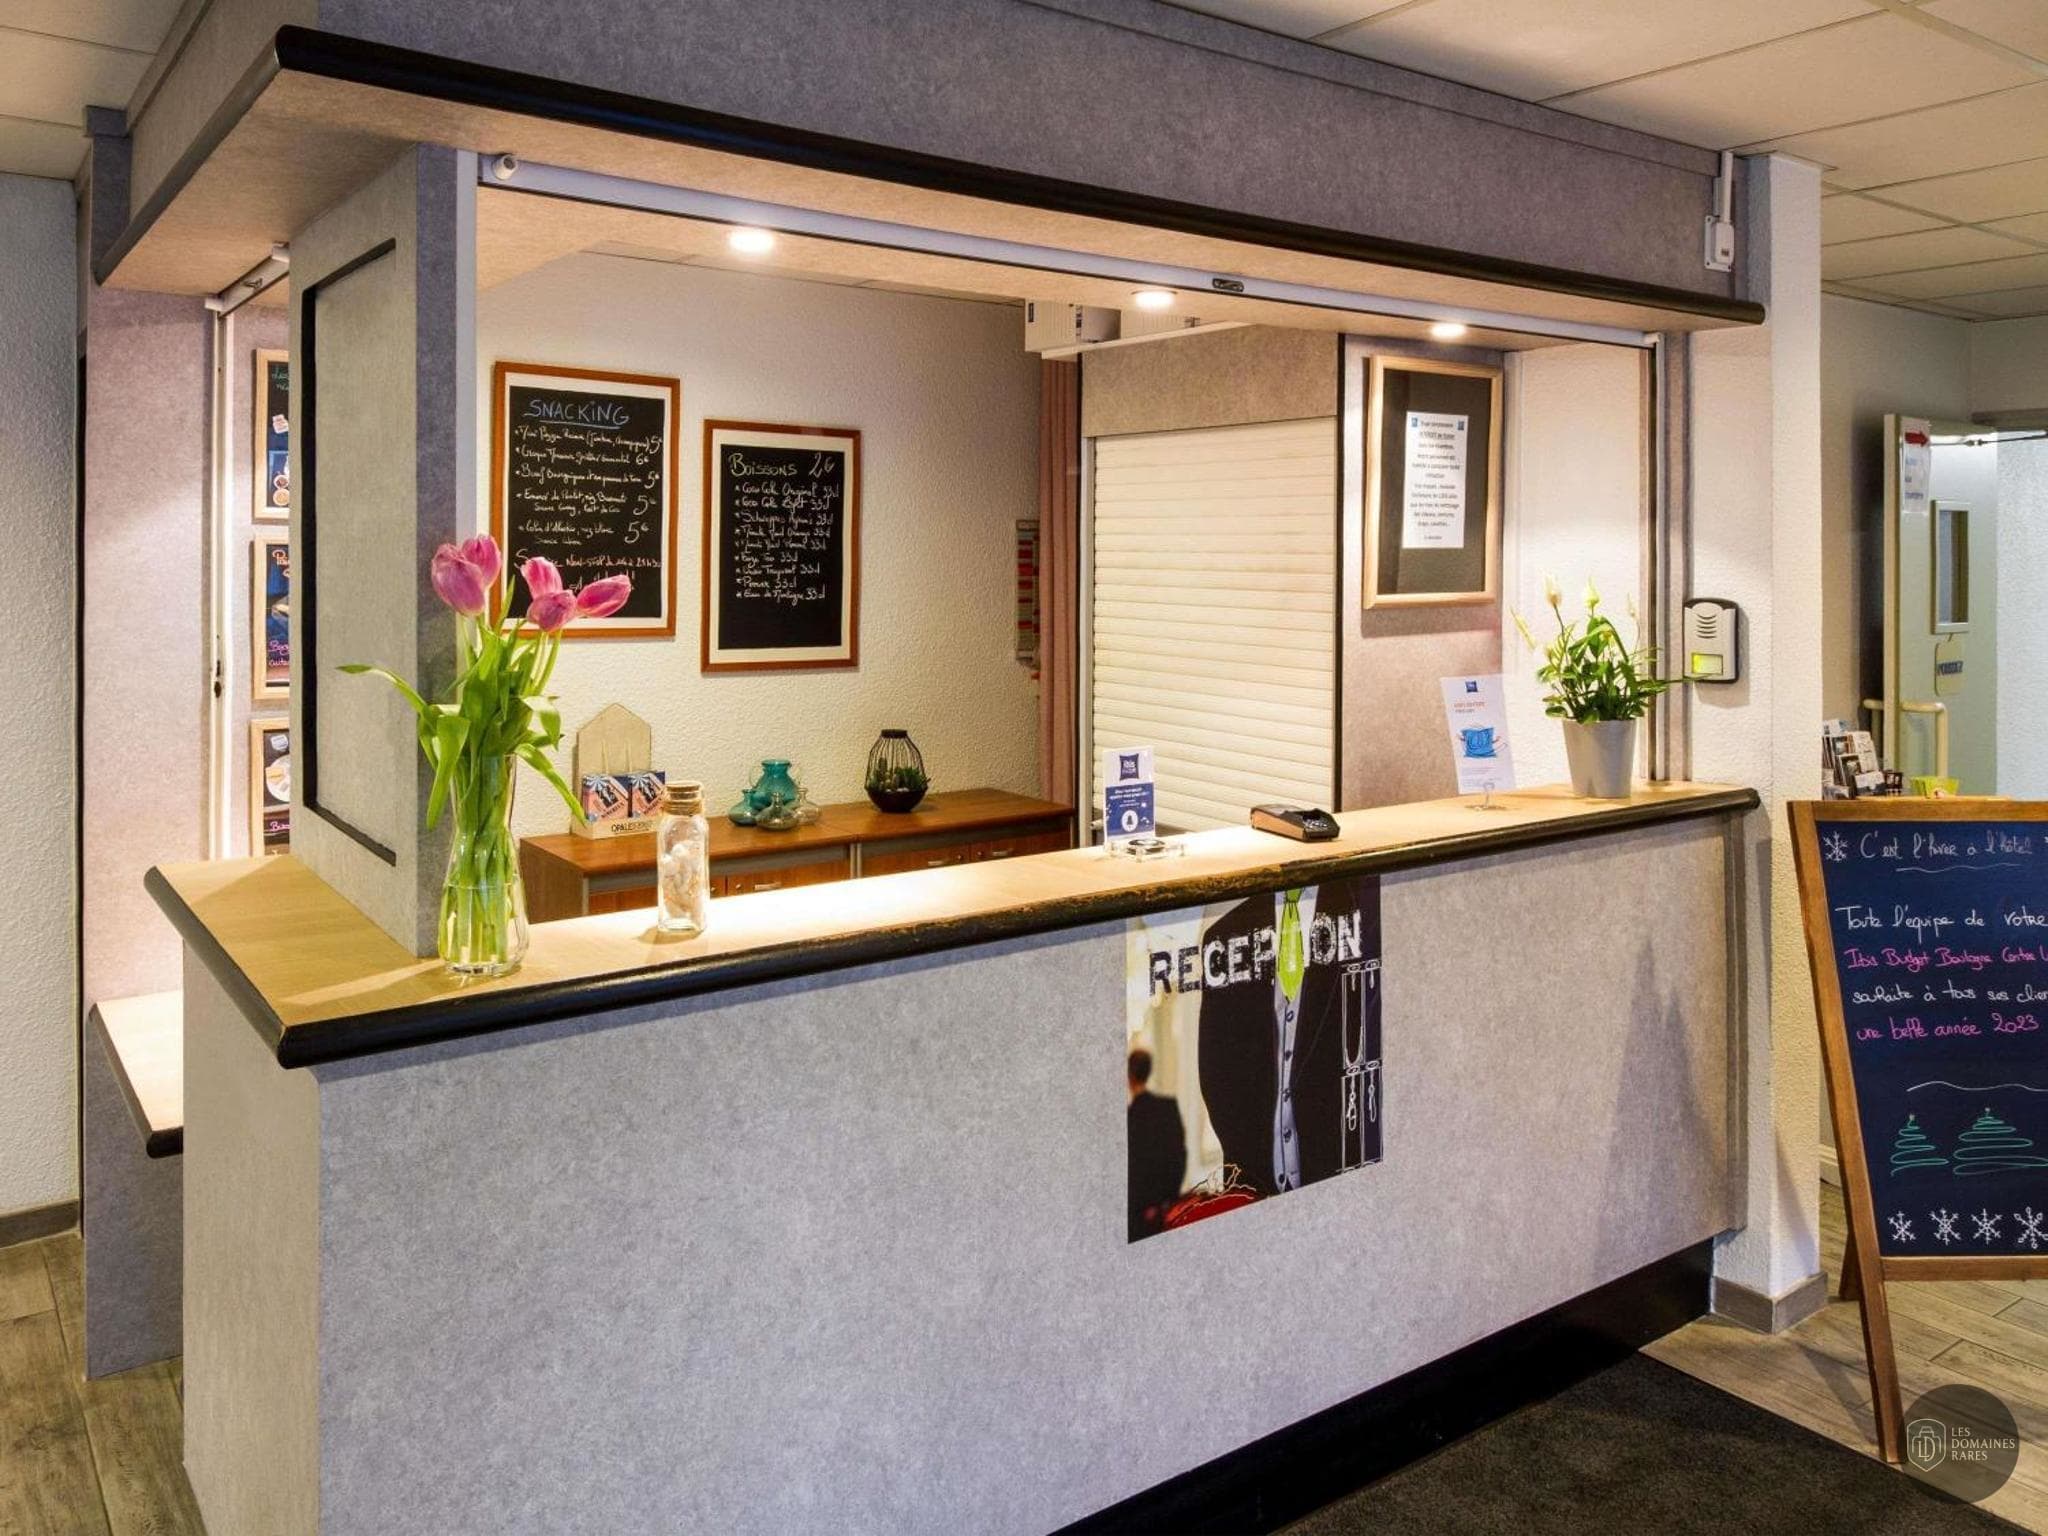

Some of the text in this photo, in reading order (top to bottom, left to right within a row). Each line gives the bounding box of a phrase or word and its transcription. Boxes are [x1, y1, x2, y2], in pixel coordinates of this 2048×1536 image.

[1835, 905, 1883, 930] Toute
[1964, 908, 1985, 927] de
[2004, 904, 2048, 928] votre
[1852, 983, 1914, 1004] souhaite
[1923, 984, 1937, 1002] à
[1942, 979, 1977, 1000] tous
[1987, 990, 2010, 1001] ses
[1856, 1026, 1884, 1042] une
[1889, 1015, 1929, 1040] belle
[1992, 1012, 2040, 1033] 2023
